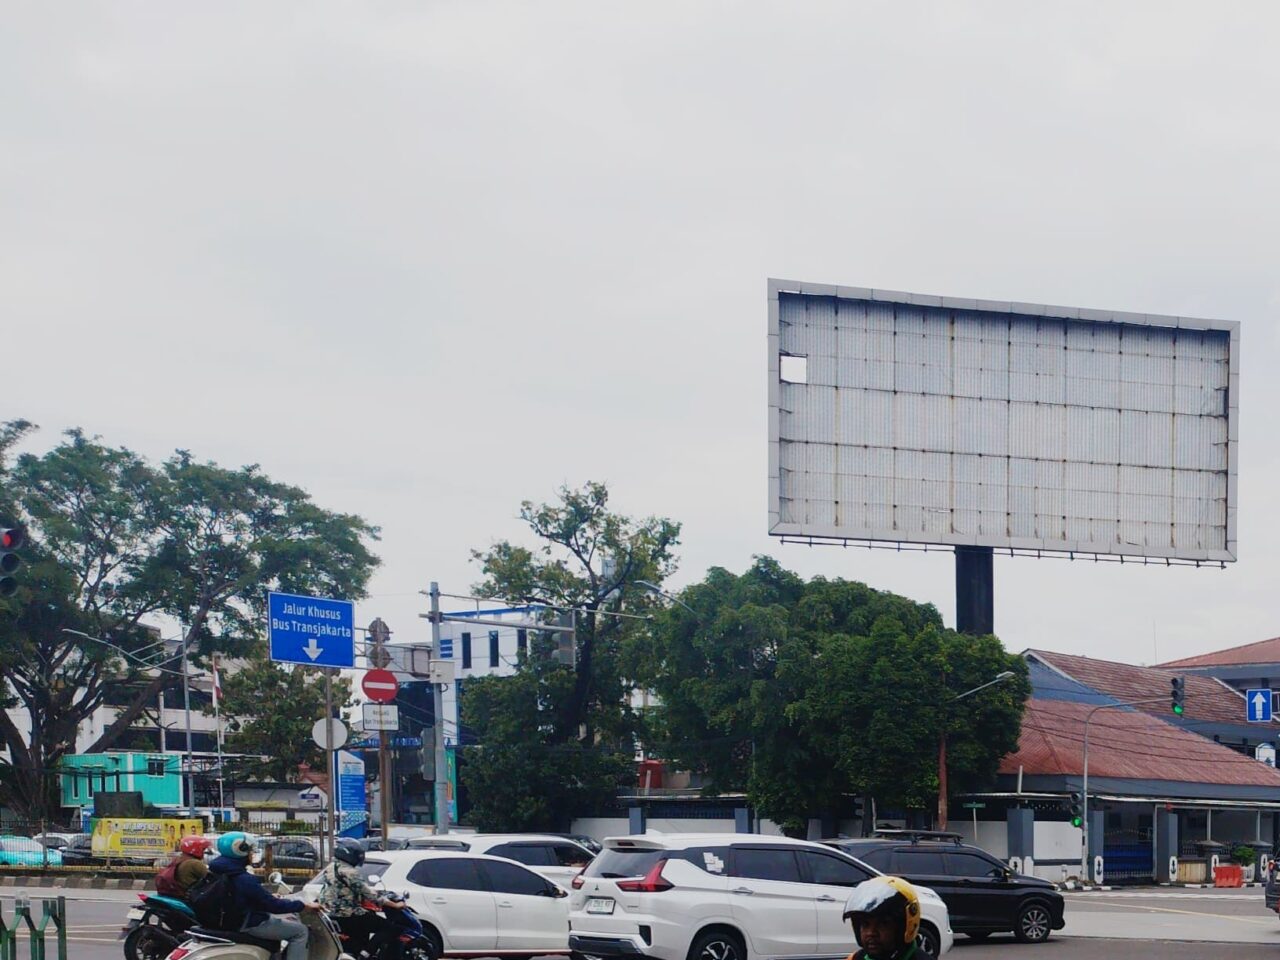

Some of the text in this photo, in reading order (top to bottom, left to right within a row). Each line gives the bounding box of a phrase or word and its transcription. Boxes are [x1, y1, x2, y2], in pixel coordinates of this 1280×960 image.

[283, 603, 341, 620] Jalur Khusus
[272, 618, 351, 637] Bus Transjakarta
